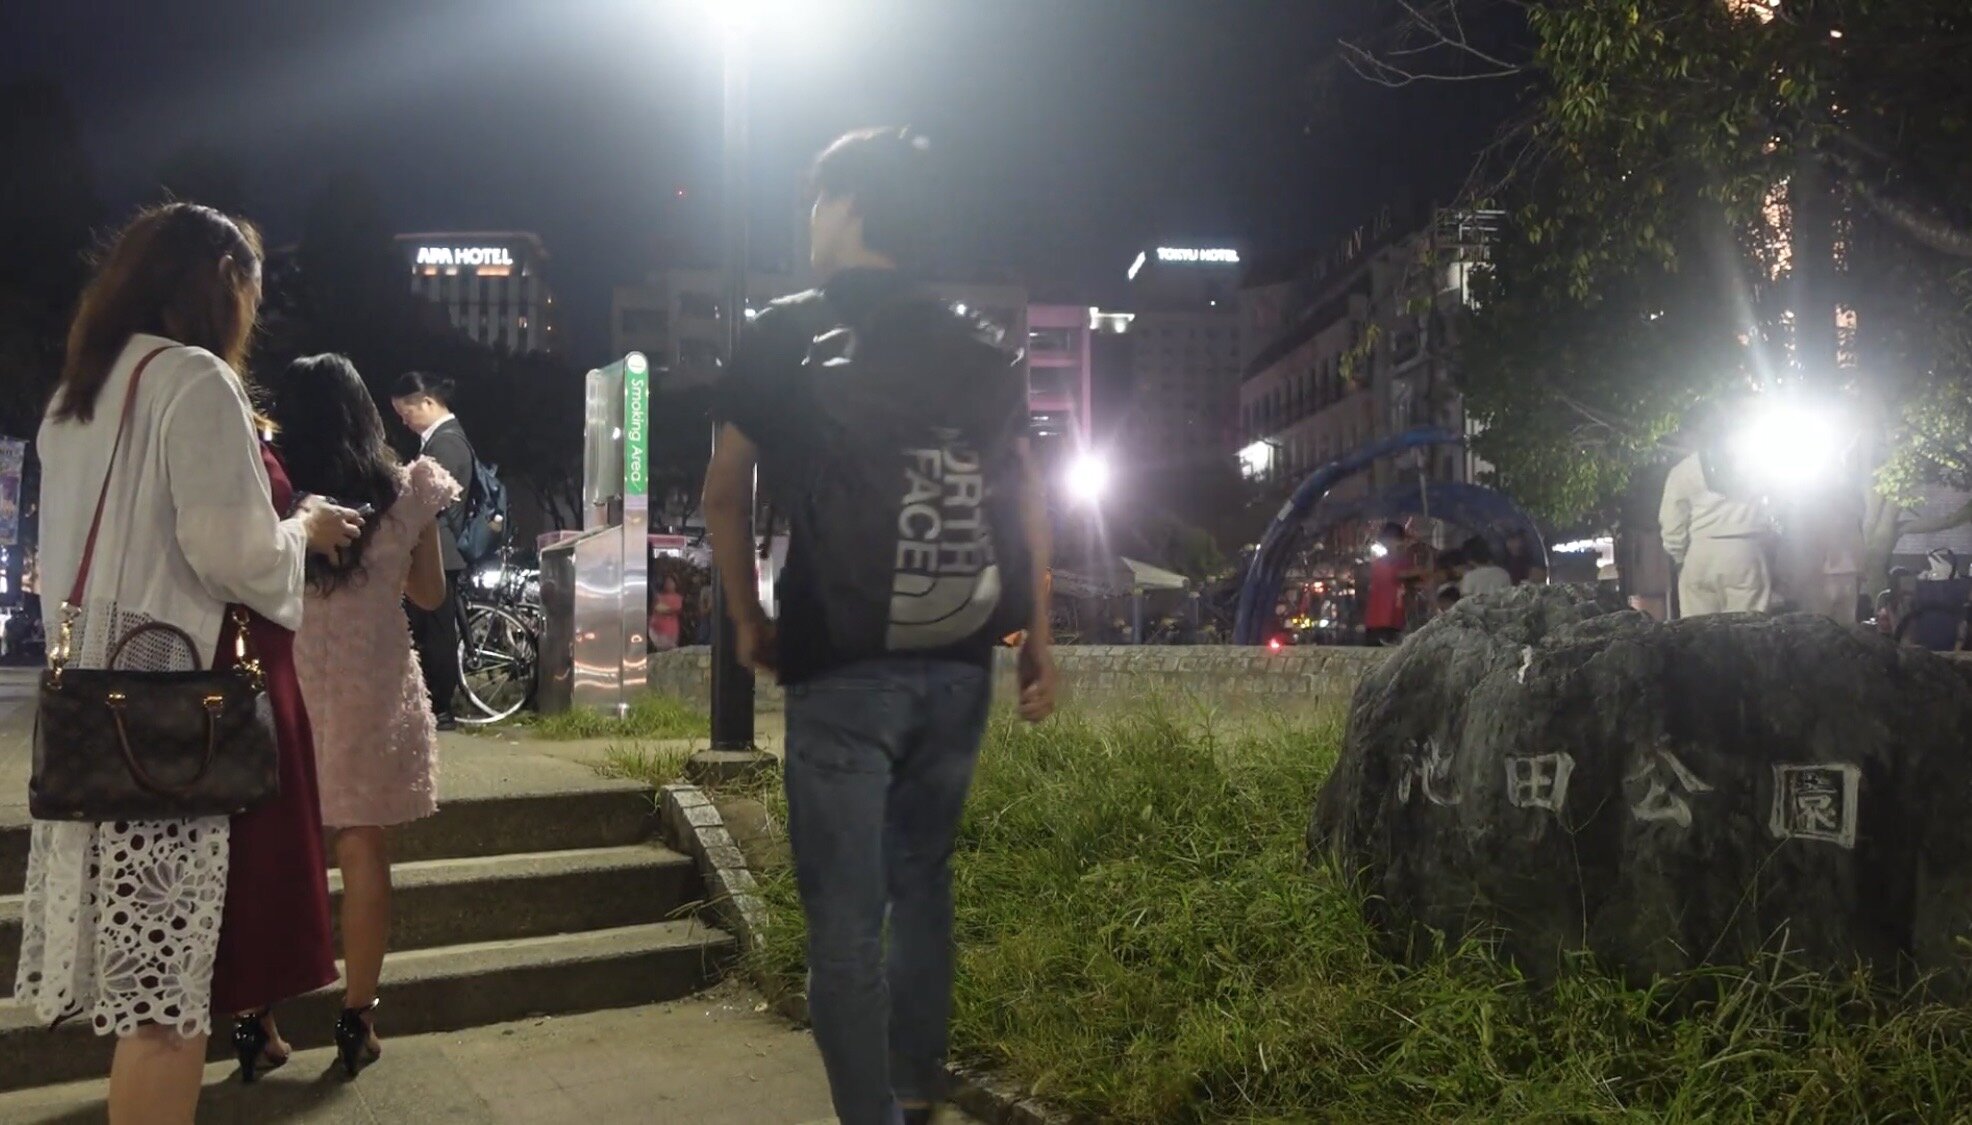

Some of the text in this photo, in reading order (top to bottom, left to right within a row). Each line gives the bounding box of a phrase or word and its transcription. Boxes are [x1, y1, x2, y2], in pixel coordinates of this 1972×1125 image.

[416, 247, 513, 265] APA HOTEL
[1200, 248, 1240, 262] HOTEL
[628, 378, 644, 482] Smoking Area
[896, 449, 942, 574] FACE
